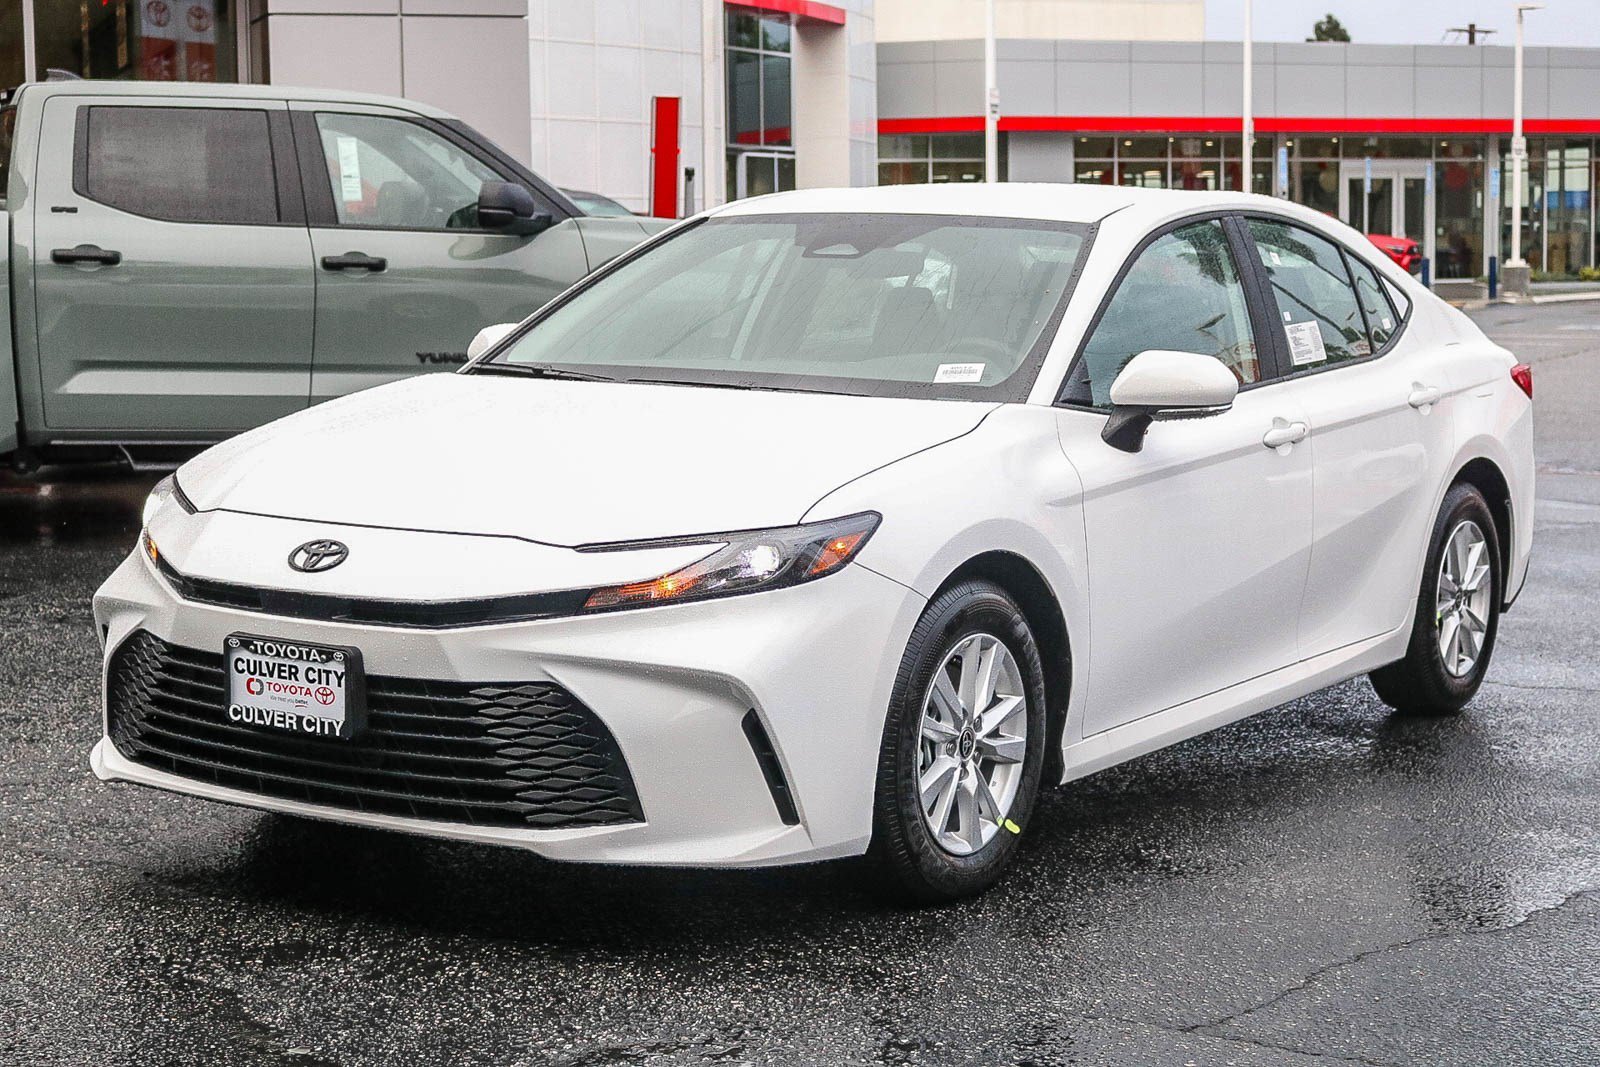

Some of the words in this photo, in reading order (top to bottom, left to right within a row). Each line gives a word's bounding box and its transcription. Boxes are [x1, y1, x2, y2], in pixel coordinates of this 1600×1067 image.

[253, 640, 321, 662] TOYOTA
[234, 657, 299, 682] CULVER
[305, 666, 345, 688] CITY
[266, 682, 313, 697] TOYOTA
[229, 703, 298, 730] CULVER
[302, 715, 344, 737] CITY
